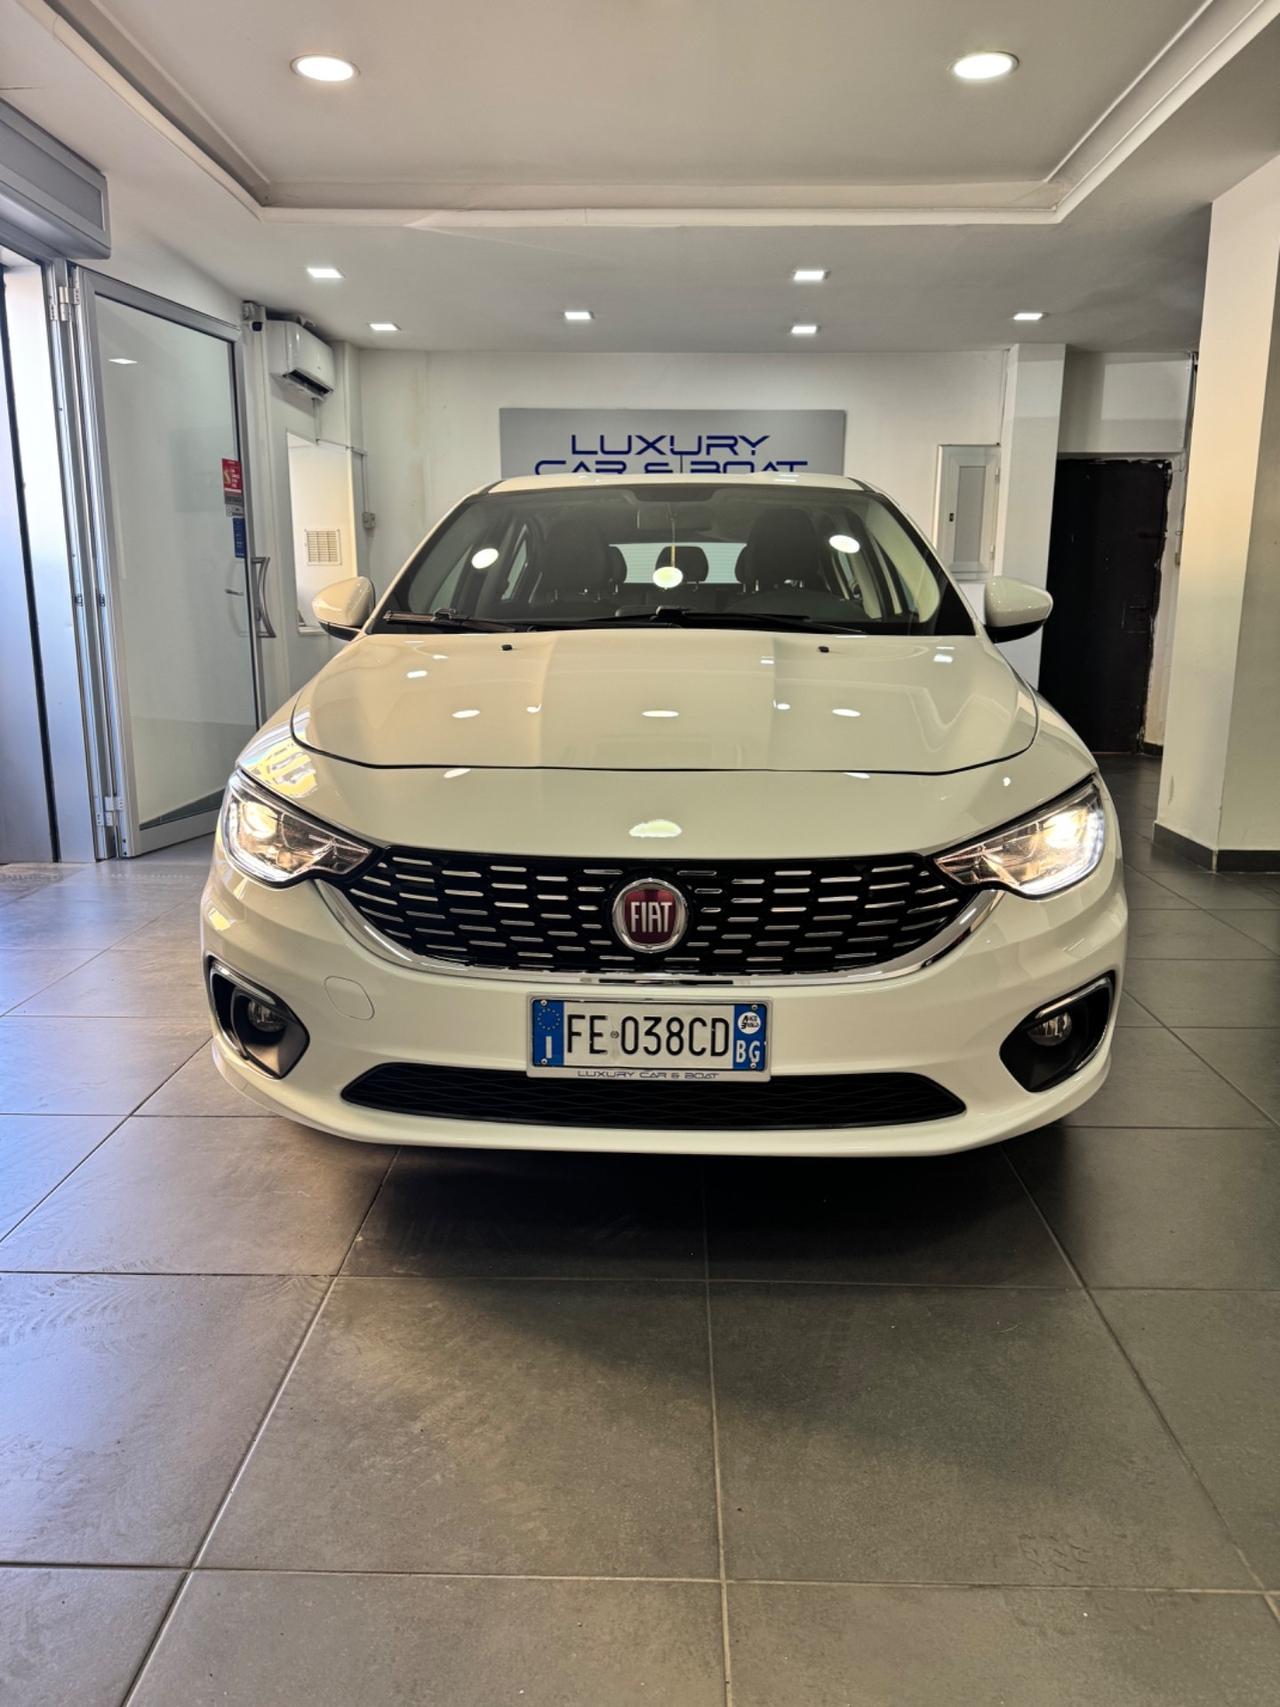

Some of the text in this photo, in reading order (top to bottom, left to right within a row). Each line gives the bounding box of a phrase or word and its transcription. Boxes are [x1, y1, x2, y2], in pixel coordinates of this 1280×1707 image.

[571, 434, 770, 456] LUXURY
[535, 460, 627, 475] CAR
[690, 460, 808, 474] BOAT
[630, 901, 673, 933] FIAT
[567, 1014, 730, 1057] FE 038CD
[736, 1040, 761, 1063] BG
[577, 1070, 635, 1079] LUXURY
[639, 1071, 667, 1079] CAR
[684, 1072, 719, 1080] BOAT
